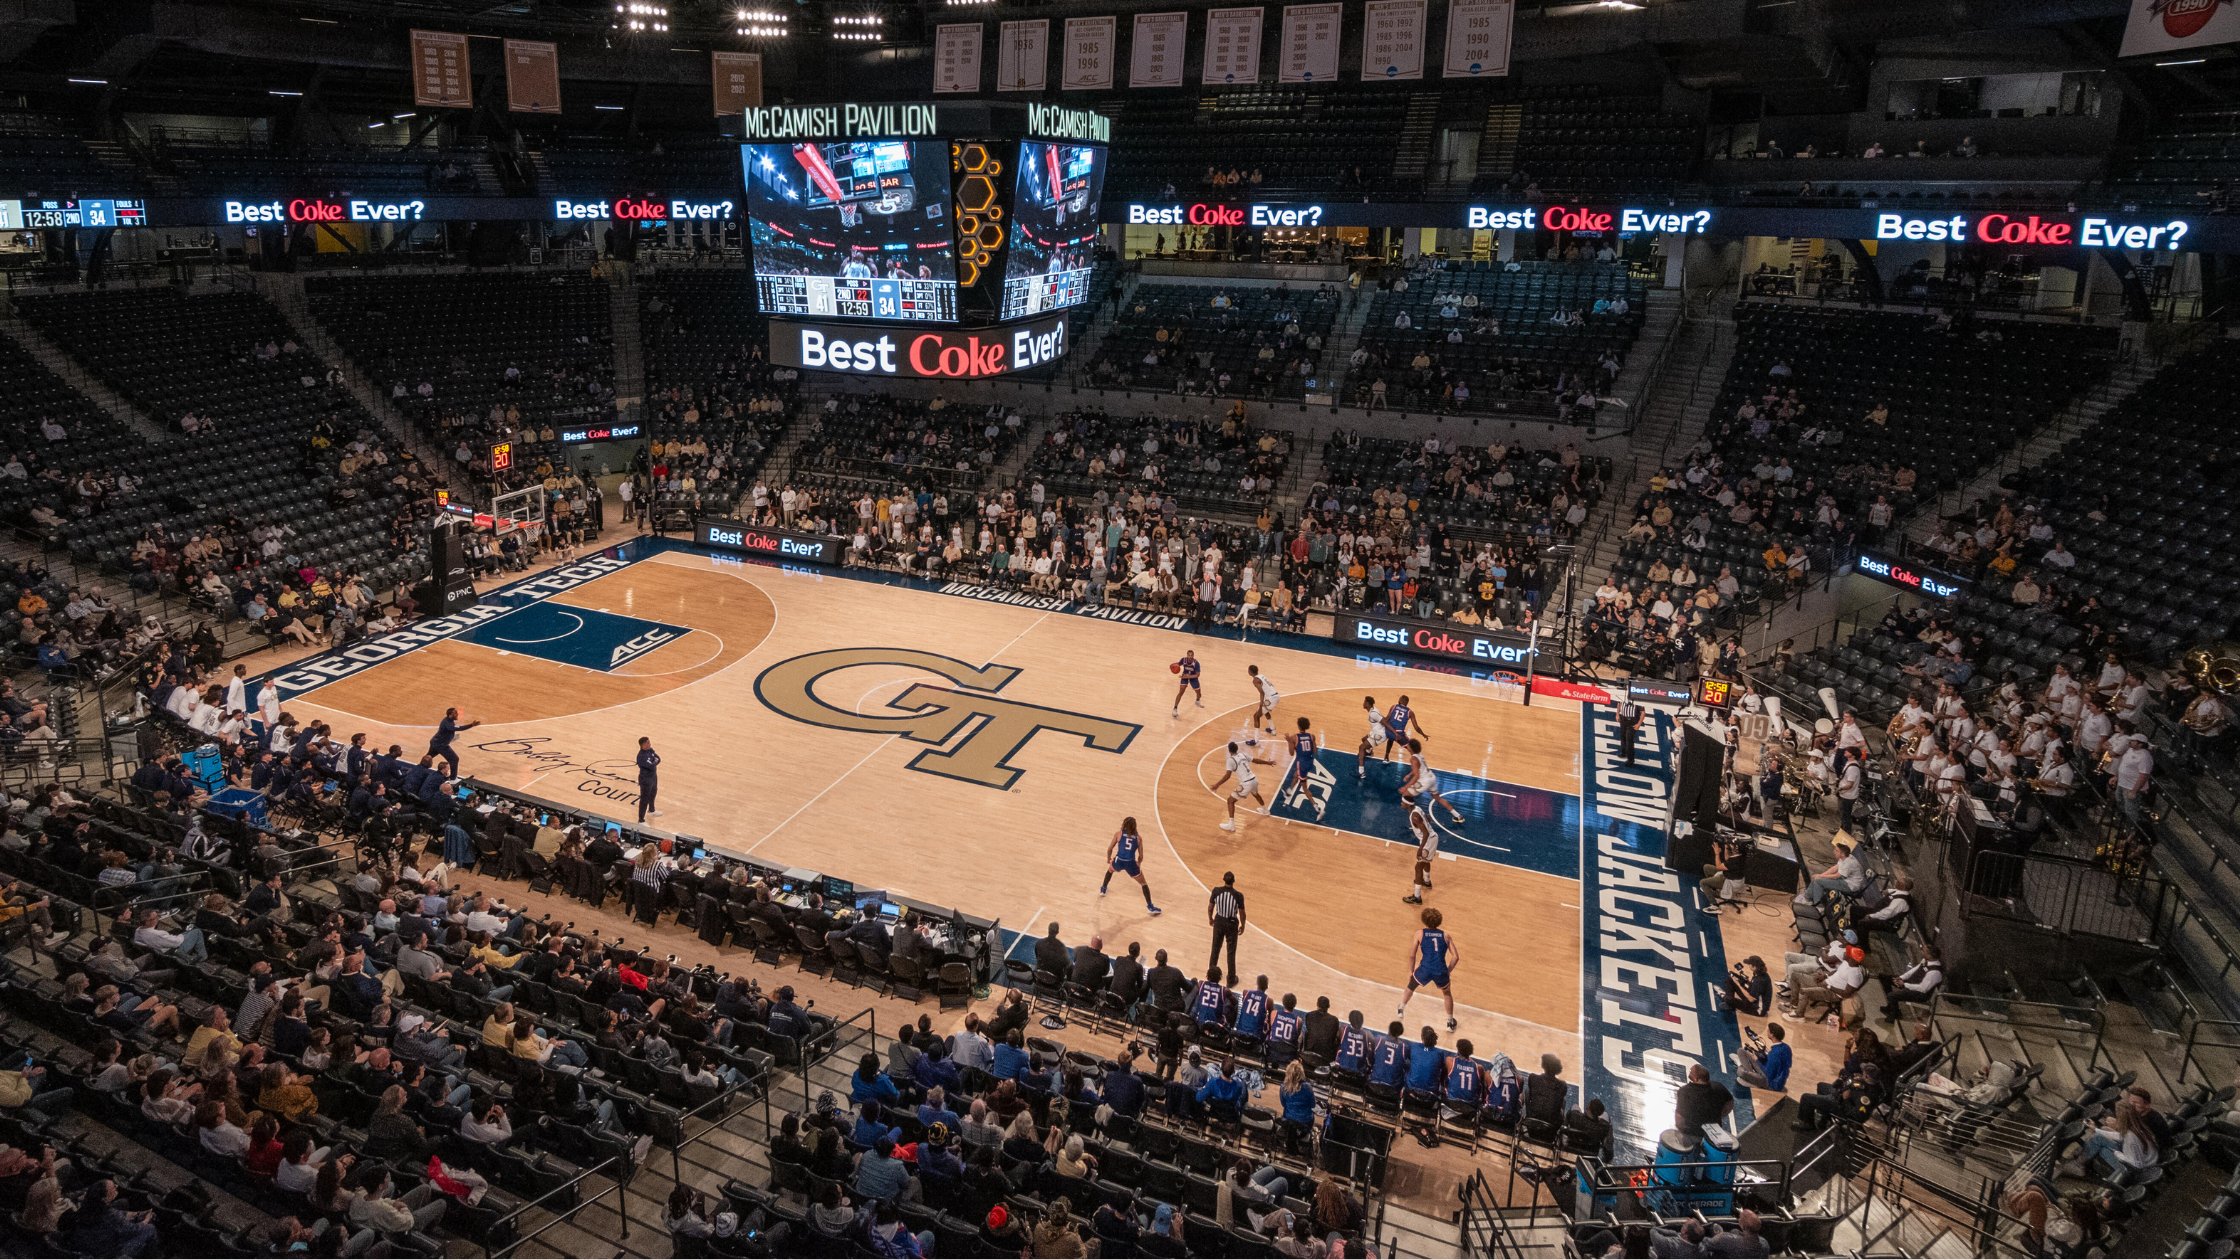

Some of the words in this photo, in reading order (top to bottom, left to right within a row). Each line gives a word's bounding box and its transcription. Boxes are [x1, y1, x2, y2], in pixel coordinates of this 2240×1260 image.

[2173, 0, 2206, 13] 1990
[1378, 20, 1393, 28] 1960
[1397, 19, 1412, 27] 1992
[1469, 18, 1489, 28] 1985
[1377, 32, 1392, 40] 1985
[1396, 31, 1412, 39] 1996
[1467, 34, 1488, 44] 1990
[1014, 40, 1033, 50] 1938
[1079, 42, 1098, 54] 1985
[1375, 57, 1390, 65] 1990
[1465, 50, 1489, 60] 2004
[1078, 58, 1098, 69] 1996
[730, 74, 745, 82] 2012
[1079, 74, 1098, 82] ACC
[447, 88, 460, 96] 2021
[731, 85, 745, 94] 2021
[845, 104, 936, 136] PAVILION
[226, 201, 284, 221] Best
[289, 200, 342, 221] Coke
[351, 201, 424, 220] Ever?
[556, 201, 609, 218] Best
[615, 200, 665, 219] Coke
[672, 201, 733, 218] Ever?
[1130, 205, 1182, 224] Best
[1189, 204, 1244, 225] Coke
[1252, 206, 1322, 226] Ever?
[26, 212, 63, 226] 12:58
[66, 213, 80, 224] 2ND
[90, 210, 106, 225] 34
[1469, 208, 1535, 229] Best
[1544, 207, 1611, 231] Coke
[1622, 209, 1710, 233] Ever?
[1877, 214, 1966, 240] Best
[1977, 214, 2070, 244] Coke
[2080, 218, 2187, 250] Ever?
[837, 290, 851, 299] 2ND
[857, 290, 867, 300] 22
[816, 295, 829, 312] 41
[842, 302, 868, 315] 12:59
[879, 297, 895, 315] 34
[802, 330, 896, 372] Best
[910, 334, 1004, 376] Coke
[1014, 321, 1063, 369] Ever?
[563, 431, 586, 441] Best
[588, 430, 610, 438] Coke
[612, 427, 638, 436] Ever?
[495, 444, 509, 454] 12:58
[495, 453, 508, 468] 20
[709, 528, 742, 546] Best
[745, 532, 777, 550] Coke
[781, 538, 823, 557] Ever?
[1860, 556, 1889, 575] Best
[1891, 567, 1920, 586] Coke
[1922, 577, 1958, 596] Ever
[455, 586, 472, 598] PNC
[939, 582, 1070, 612] MCCAMISH
[1076, 604, 1188, 630] PAVILION
[273, 605, 513, 691] GEORGIA
[501, 556, 631, 600] TECH
[1357, 622, 1409, 645] Best
[1414, 630, 1465, 653] Coke
[610, 627, 673, 667] ACC
[1630, 686, 1648, 694] Best
[1668, 691, 1689, 699] Ever?
[1706, 681, 1728, 692] 12:58
[1705, 691, 1722, 703] 20
[753, 647, 1145, 792] GT
[1394, 710, 1404, 721] 12
[1300, 740, 1311, 752] 10
[1292, 758, 1337, 815] ACC
[1125, 838, 1132, 850] 5
[1432, 937, 1438, 951] 1
[1597, 833, 1704, 1090] JACKETS
[1202, 990, 1218, 1008] 23
[1246, 998, 1260, 1017] 14
[1275, 1020, 1293, 1040] 20
[1346, 1038, 1364, 1057] 33
[1385, 1047, 1395, 1065] 3
[1459, 1072, 1472, 1090] 11
[1501, 1084, 1510, 1101] 4
